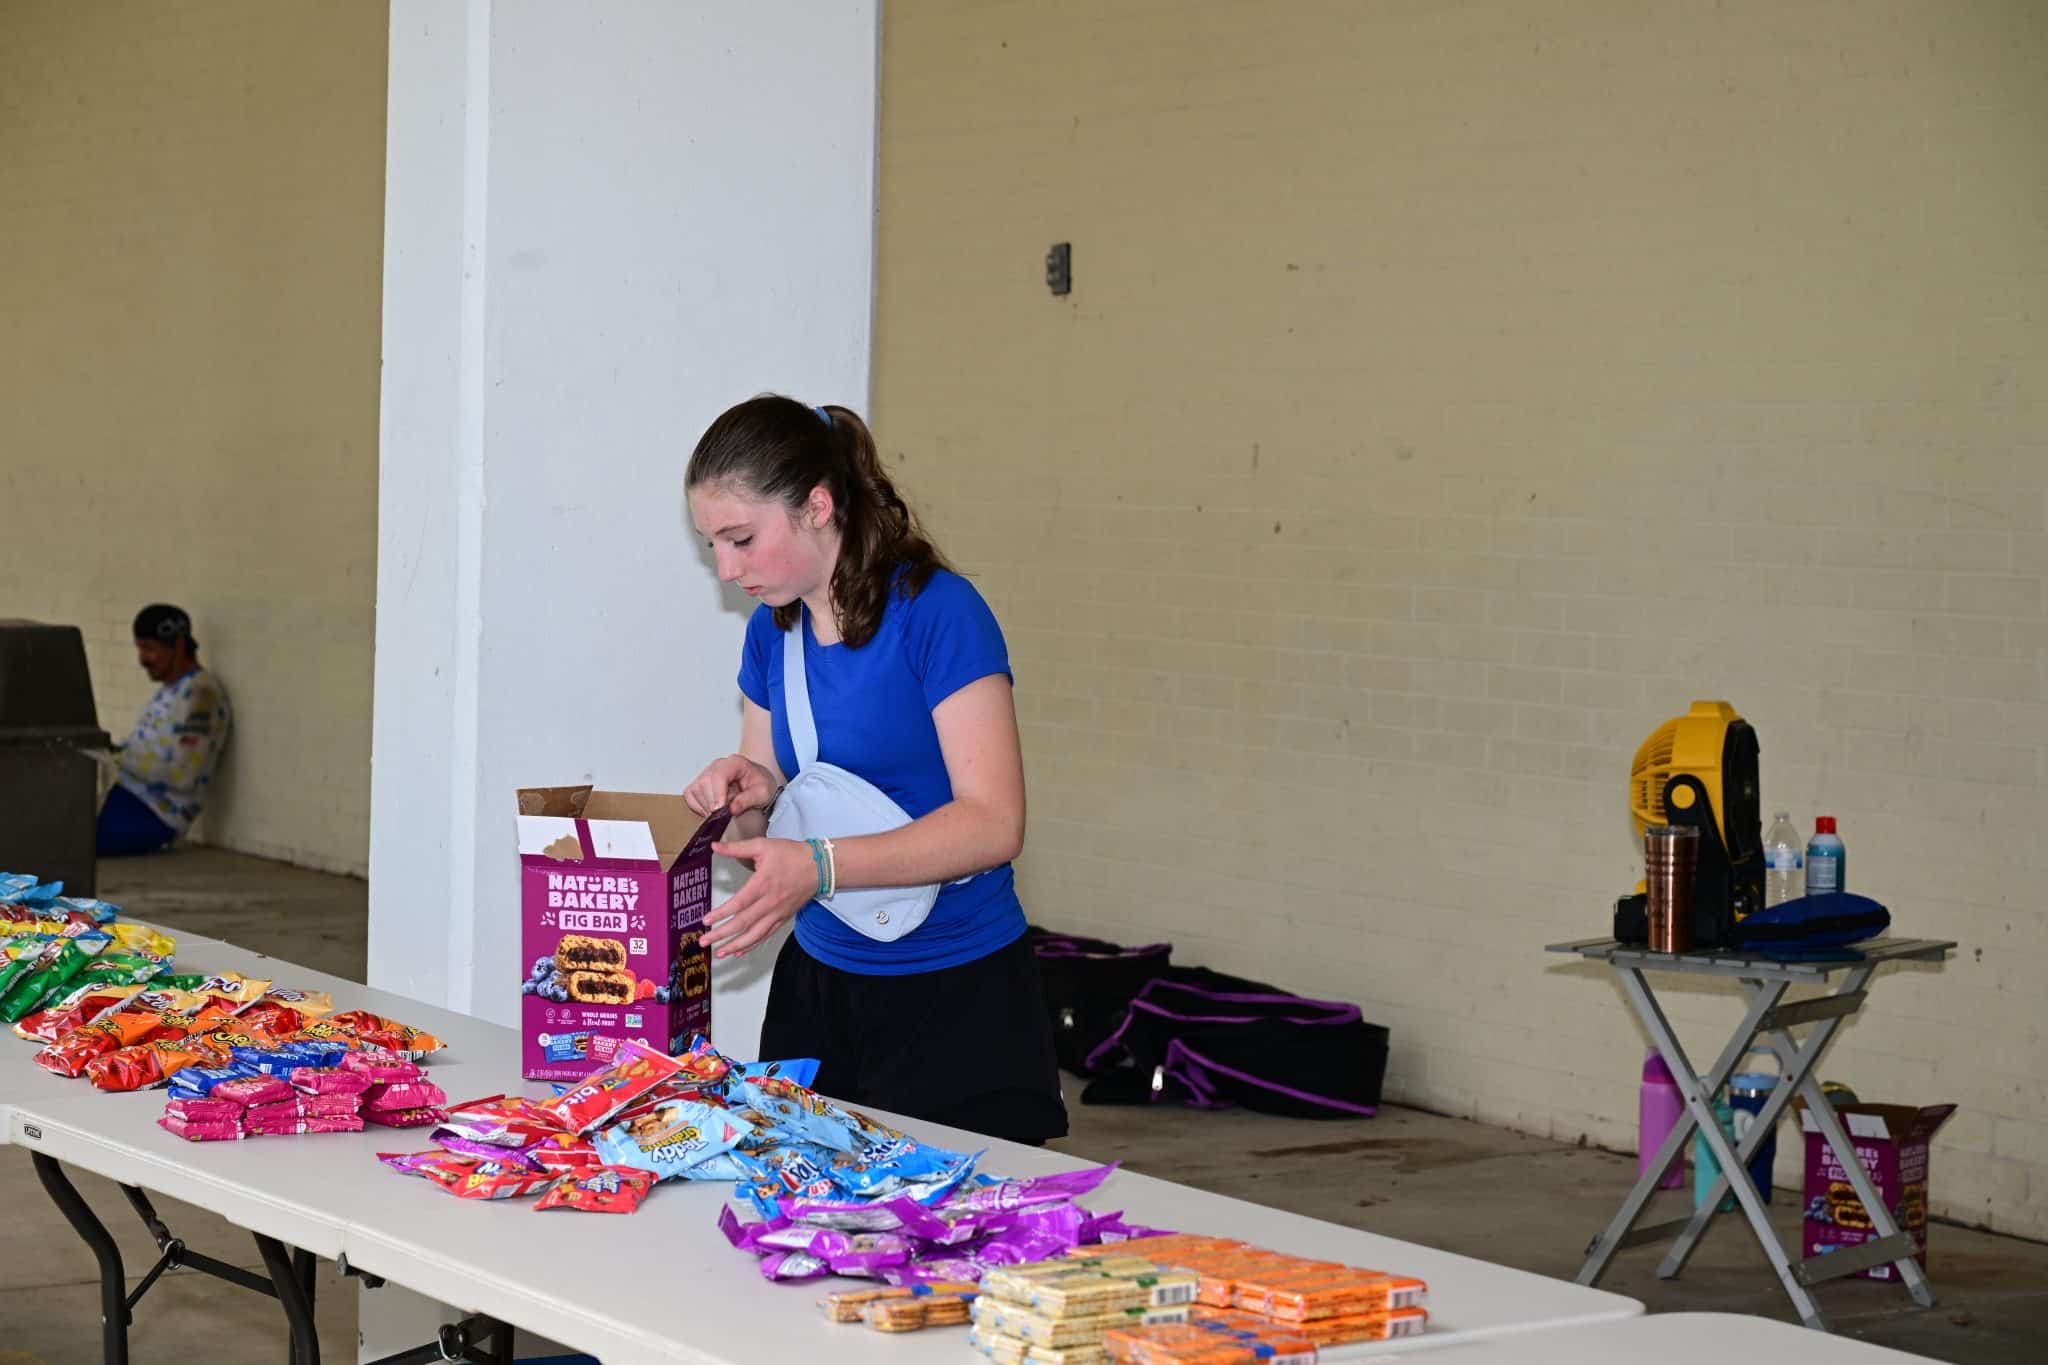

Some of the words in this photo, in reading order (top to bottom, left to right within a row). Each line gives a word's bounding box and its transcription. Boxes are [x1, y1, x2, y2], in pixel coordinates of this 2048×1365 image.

[549, 891, 639, 910] BAKERY
[674, 882, 708, 909] BAKERY
[565, 914, 588, 927] FIG
[592, 915, 621, 928] BAR
[680, 911, 689, 925] FIG
[633, 939, 644, 950] 32
[556, 1085, 599, 1119] bite
[640, 1126, 701, 1153] Grahams
[652, 1141, 709, 1164] Teddy
[1822, 1155, 1878, 1169] BARY
